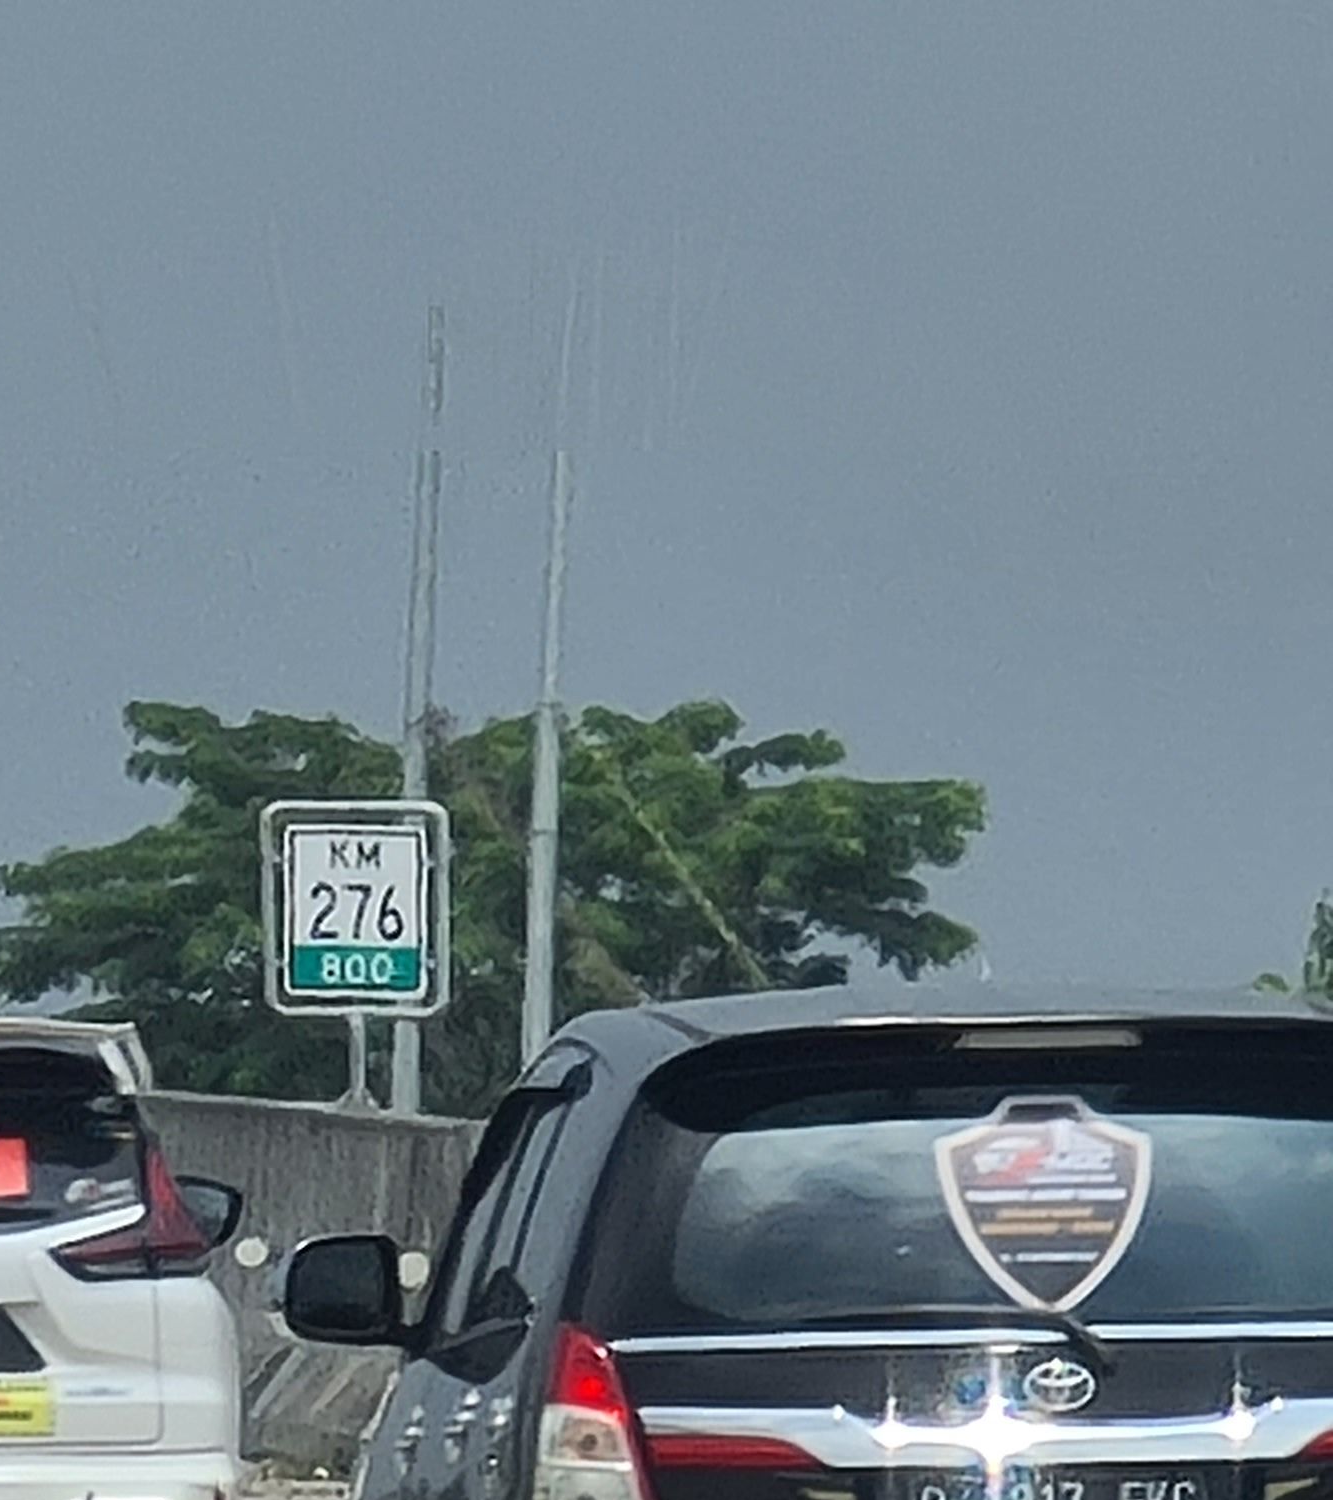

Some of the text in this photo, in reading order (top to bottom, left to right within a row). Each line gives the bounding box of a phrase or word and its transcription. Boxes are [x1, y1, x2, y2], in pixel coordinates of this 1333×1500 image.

[329, 840, 381, 869] KM
[310, 881, 404, 941] 276
[321, 953, 394, 984] 800
